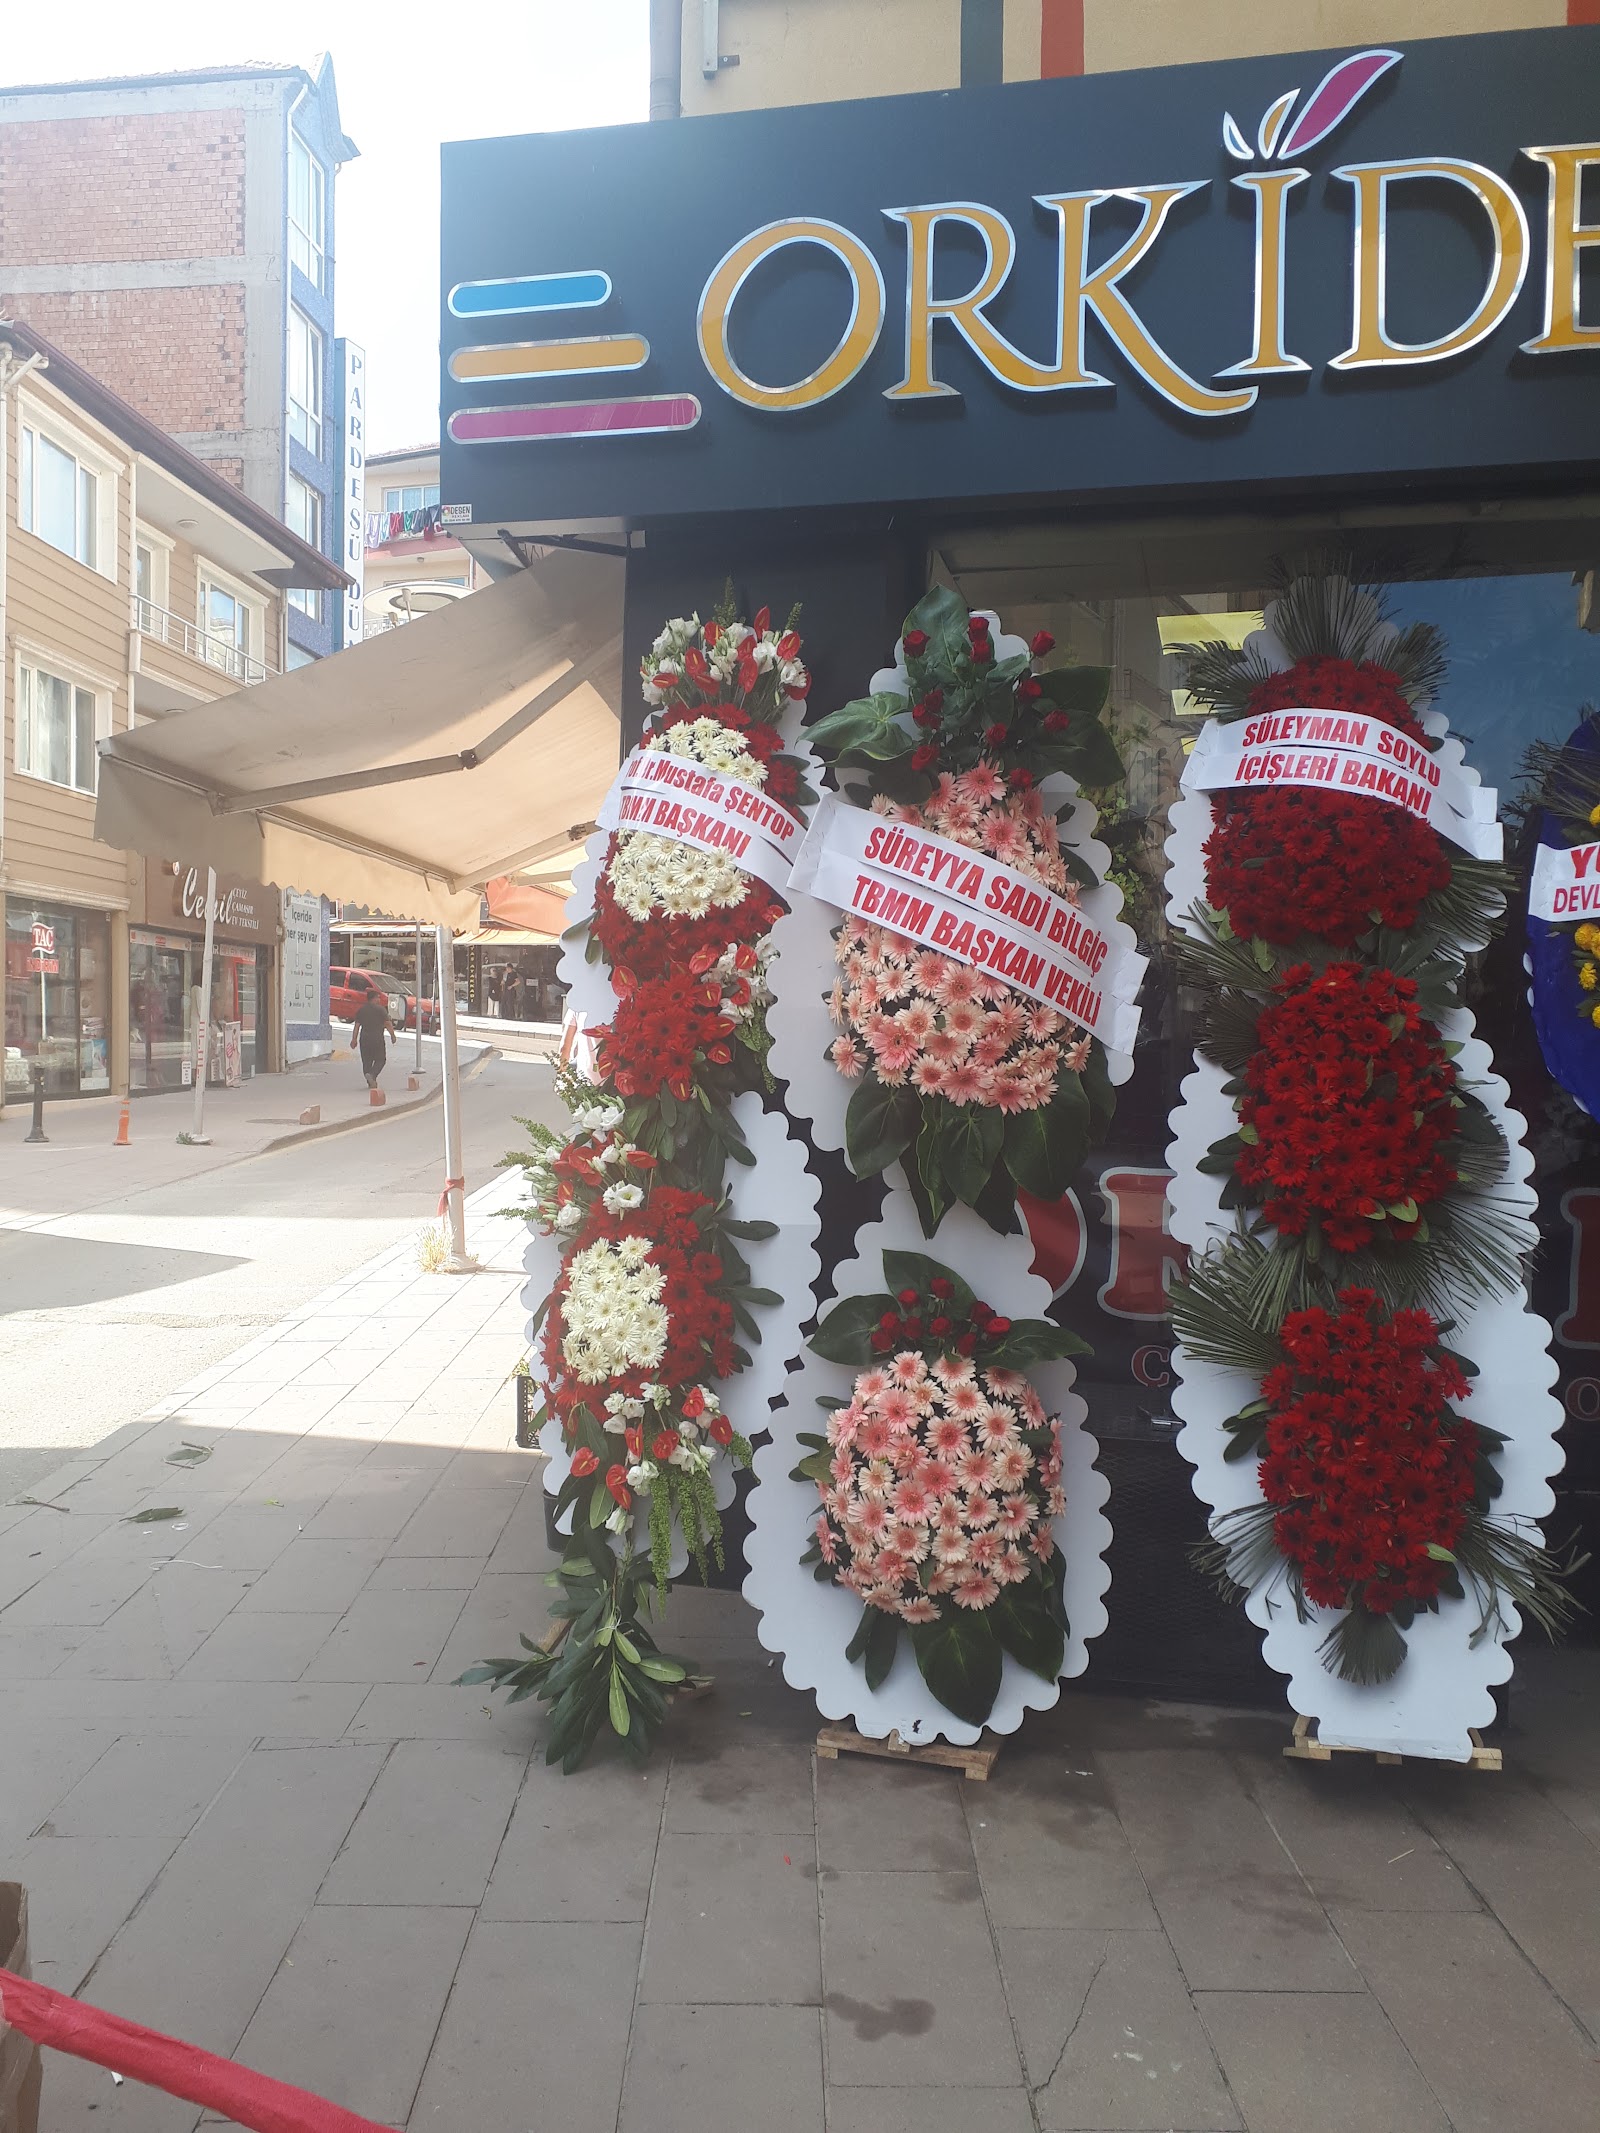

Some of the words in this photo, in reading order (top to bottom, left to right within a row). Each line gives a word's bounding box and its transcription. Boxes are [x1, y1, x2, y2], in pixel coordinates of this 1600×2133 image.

[697, 143, 1600, 416] ORKİDE
[349, 353, 363, 562] PARDESÜ
[450, 505, 471, 515] DESEN
[348, 580, 361, 648] DÜ
[1242, 714, 1369, 748] SÜLEYMAN
[1377, 729, 1442, 788] SOYLU
[724, 786, 795, 842] ŞENTOP
[1235, 750, 1338, 785] İÇİŞLERİ
[1340, 758, 1433, 816] BAKANI
[653, 798, 752, 858] BAŞKANI
[231, 915, 239, 925] EV
[291, 905, 313, 924] İçeride
[864, 826, 985, 901] SÜREYYA
[984, 876, 1052, 933] SADİ
[1047, 912, 1109, 978] BİLGİÇ
[33, 928, 54, 951] TAÇ
[297, 931, 308, 944] şey
[308, 933, 318, 943] var
[851, 874, 931, 936] TBMM
[931, 910, 1047, 990] BAŞKAN
[1043, 964, 1103, 1027] VEKİLİ
